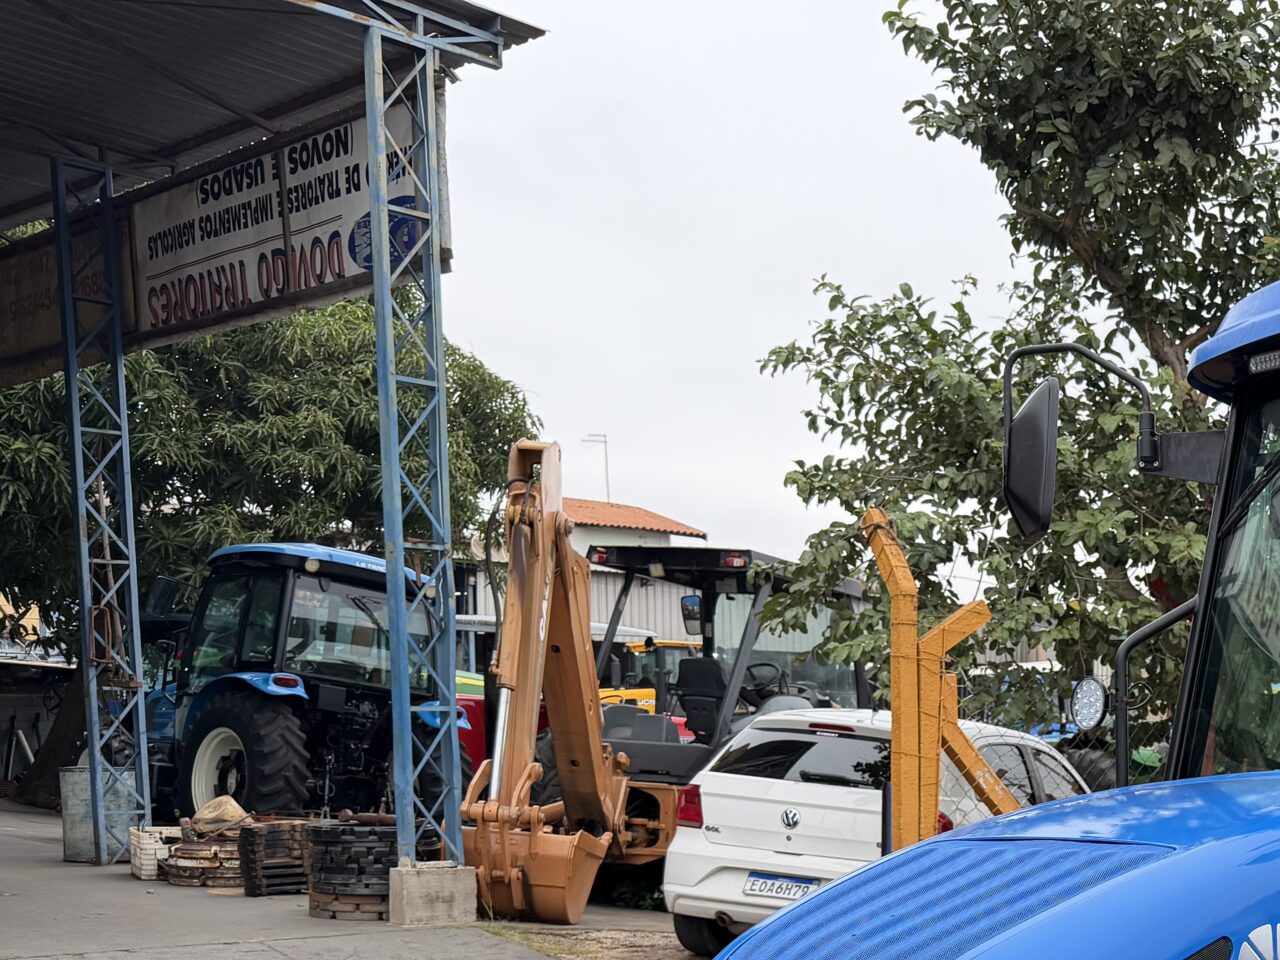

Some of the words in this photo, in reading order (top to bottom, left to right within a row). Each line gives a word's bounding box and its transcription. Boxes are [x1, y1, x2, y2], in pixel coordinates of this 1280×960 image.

[199, 192, 274, 239] IMPLEMENTOS
[287, 171, 342, 215] TRATORES
[148, 259, 252, 328] TRATORES
